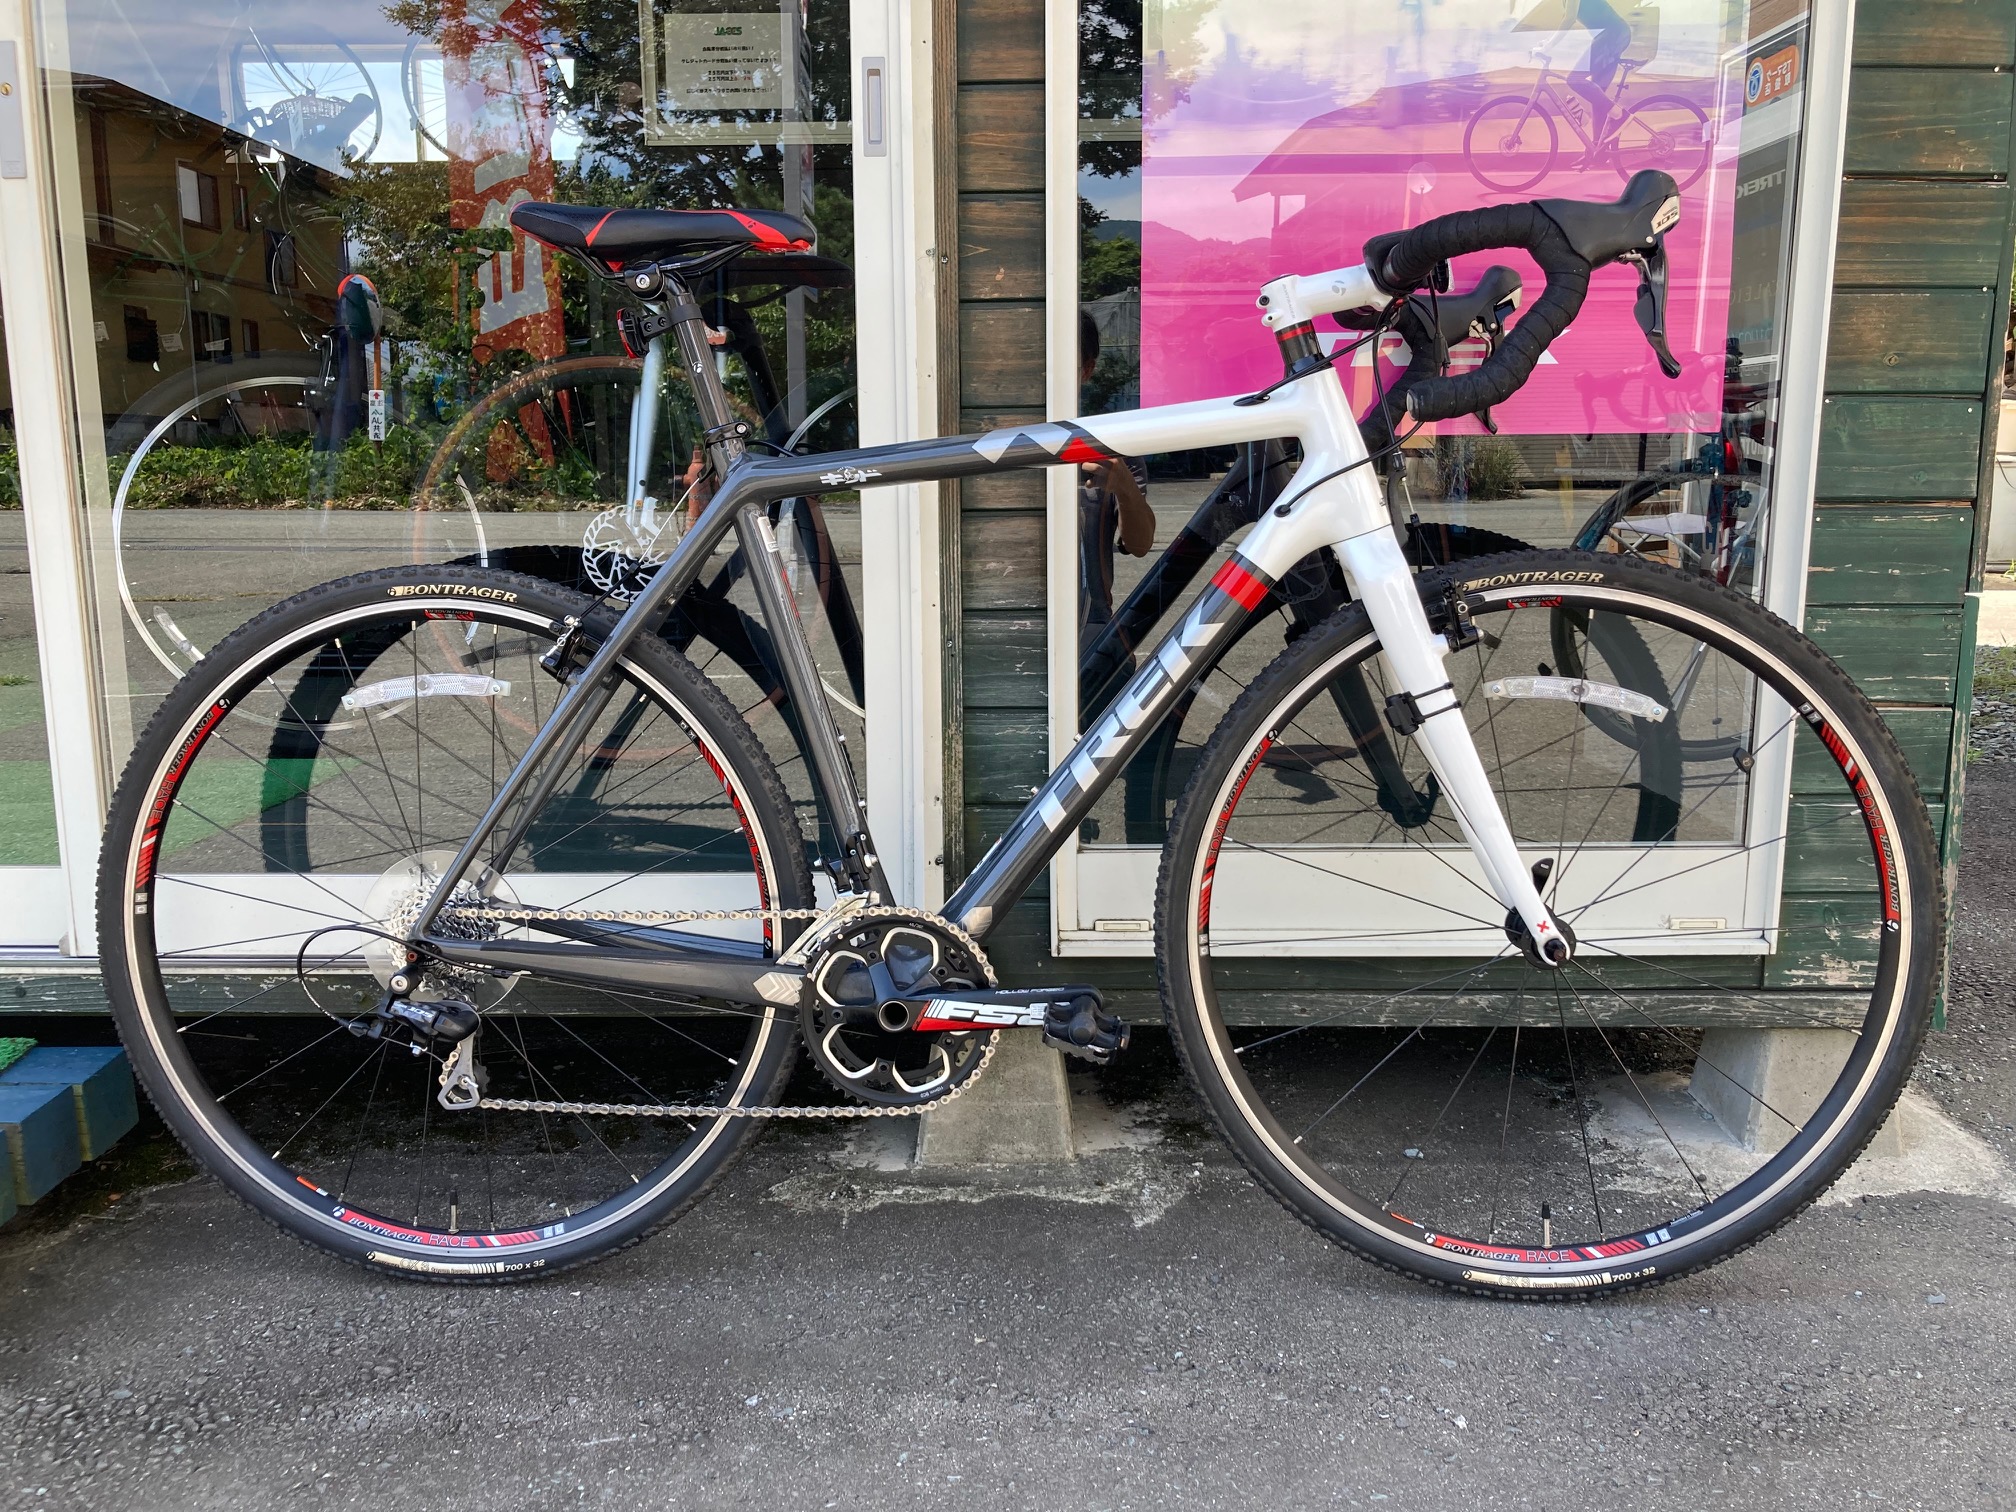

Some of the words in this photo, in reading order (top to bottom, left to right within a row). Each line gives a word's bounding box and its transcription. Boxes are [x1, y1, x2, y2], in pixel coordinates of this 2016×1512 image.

[403, 584, 518, 603] BONTRAGER
[1476, 571, 1604, 589] BONTRAGER
[1022, 596, 1225, 834] TREK
[168, 710, 215, 776] BONTRAGER
[1223, 744, 1264, 814] BONTRAGER
[149, 780, 175, 820] RACE
[1857, 786, 1885, 829] RACE
[1207, 819, 1228, 860] RACE
[1880, 834, 1900, 913] BONTRAGER
[348, 1217, 423, 1244] BONTRAGER
[428, 1233, 471, 1247] RACE
[1442, 1242, 1521, 1262] BONTRAGER
[1525, 1250, 1571, 1262] RACE
[505, 1262, 524, 1272] 700
[532, 1259, 546, 1268] 32
[1612, 1271, 1632, 1282] 700
[1642, 1267, 1656, 1276] 32
